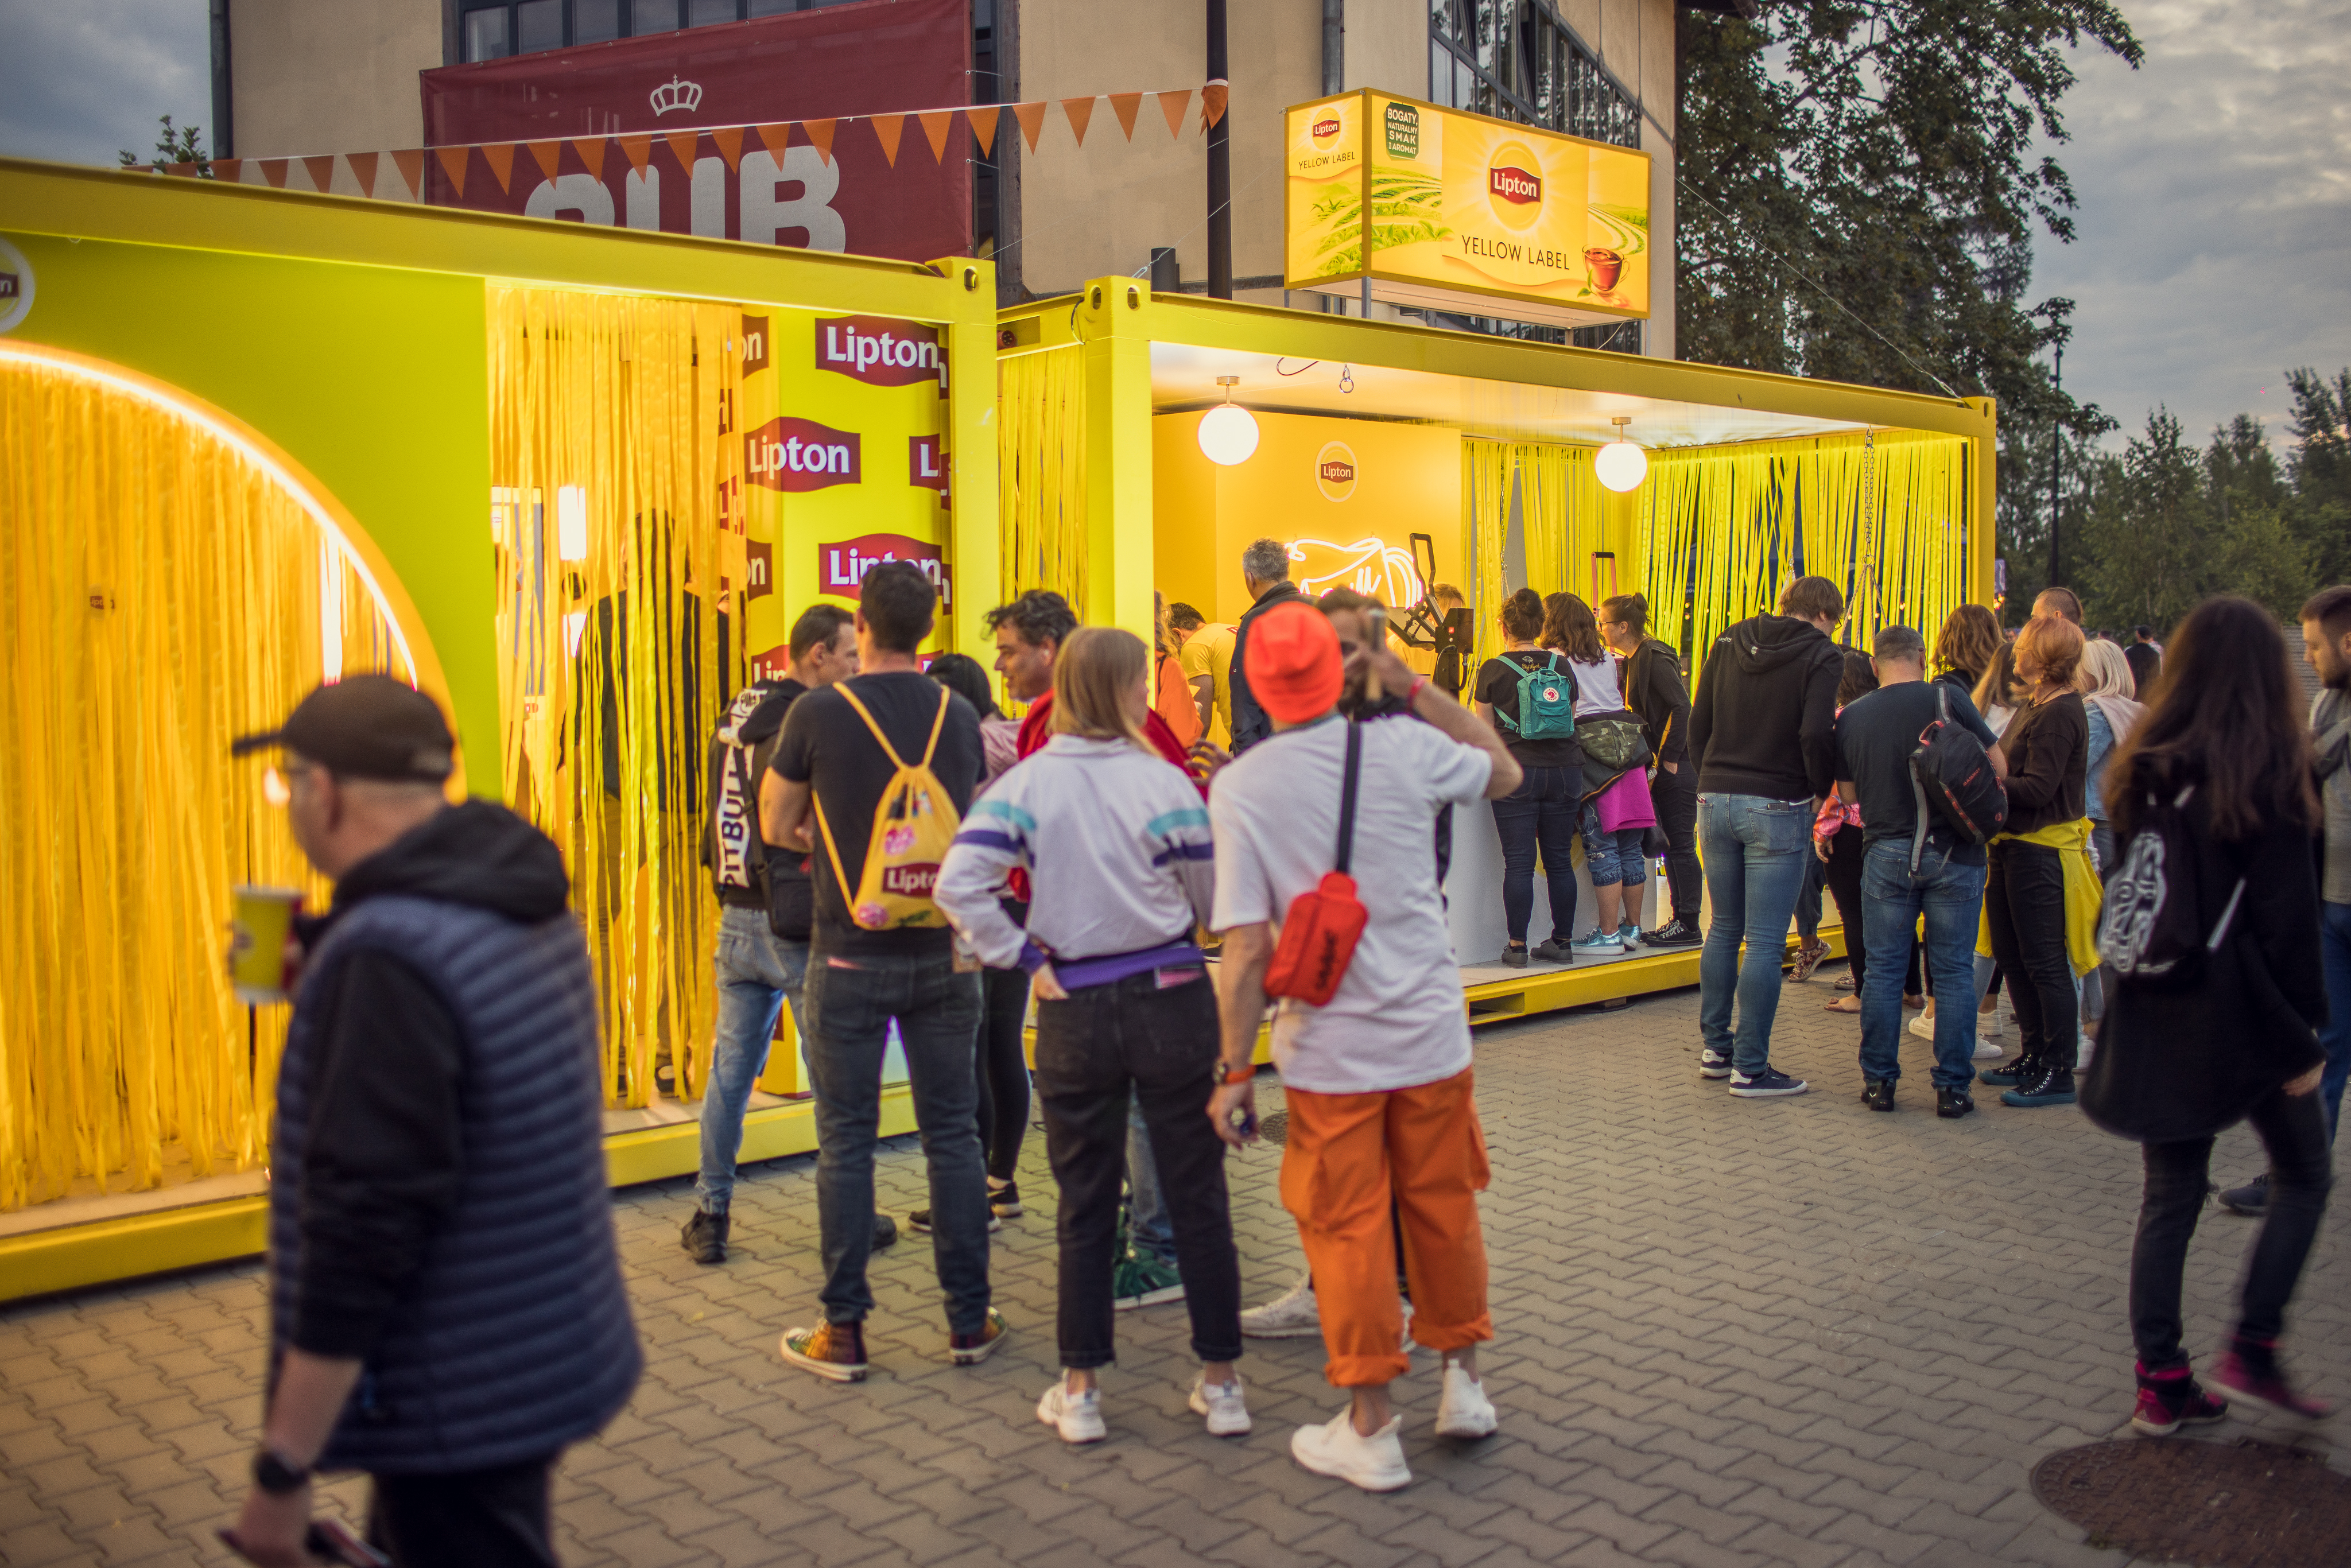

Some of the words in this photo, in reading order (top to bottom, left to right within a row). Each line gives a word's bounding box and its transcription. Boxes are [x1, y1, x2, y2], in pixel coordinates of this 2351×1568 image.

[1387, 108, 1418, 126] BOGATY,
[1315, 123, 1337, 135] Lipton
[1388, 121, 1418, 135] NATURALNY
[1389, 130, 1416, 145] SMAK
[1392, 143, 1417, 154] AROMAT
[1298, 156, 1329, 170] YELLOW
[1332, 152, 1355, 164] LABEL
[1494, 172, 1537, 197] Lipton
[1461, 235, 1522, 262] YELLOW
[1528, 247, 1570, 270] LABEL
[827, 325, 938, 372] Lipton
[750, 435, 850, 480] Lipton
[1324, 465, 1351, 479] Lipton
[830, 548, 941, 586] Lin
[887, 867, 936, 894] Lipt
